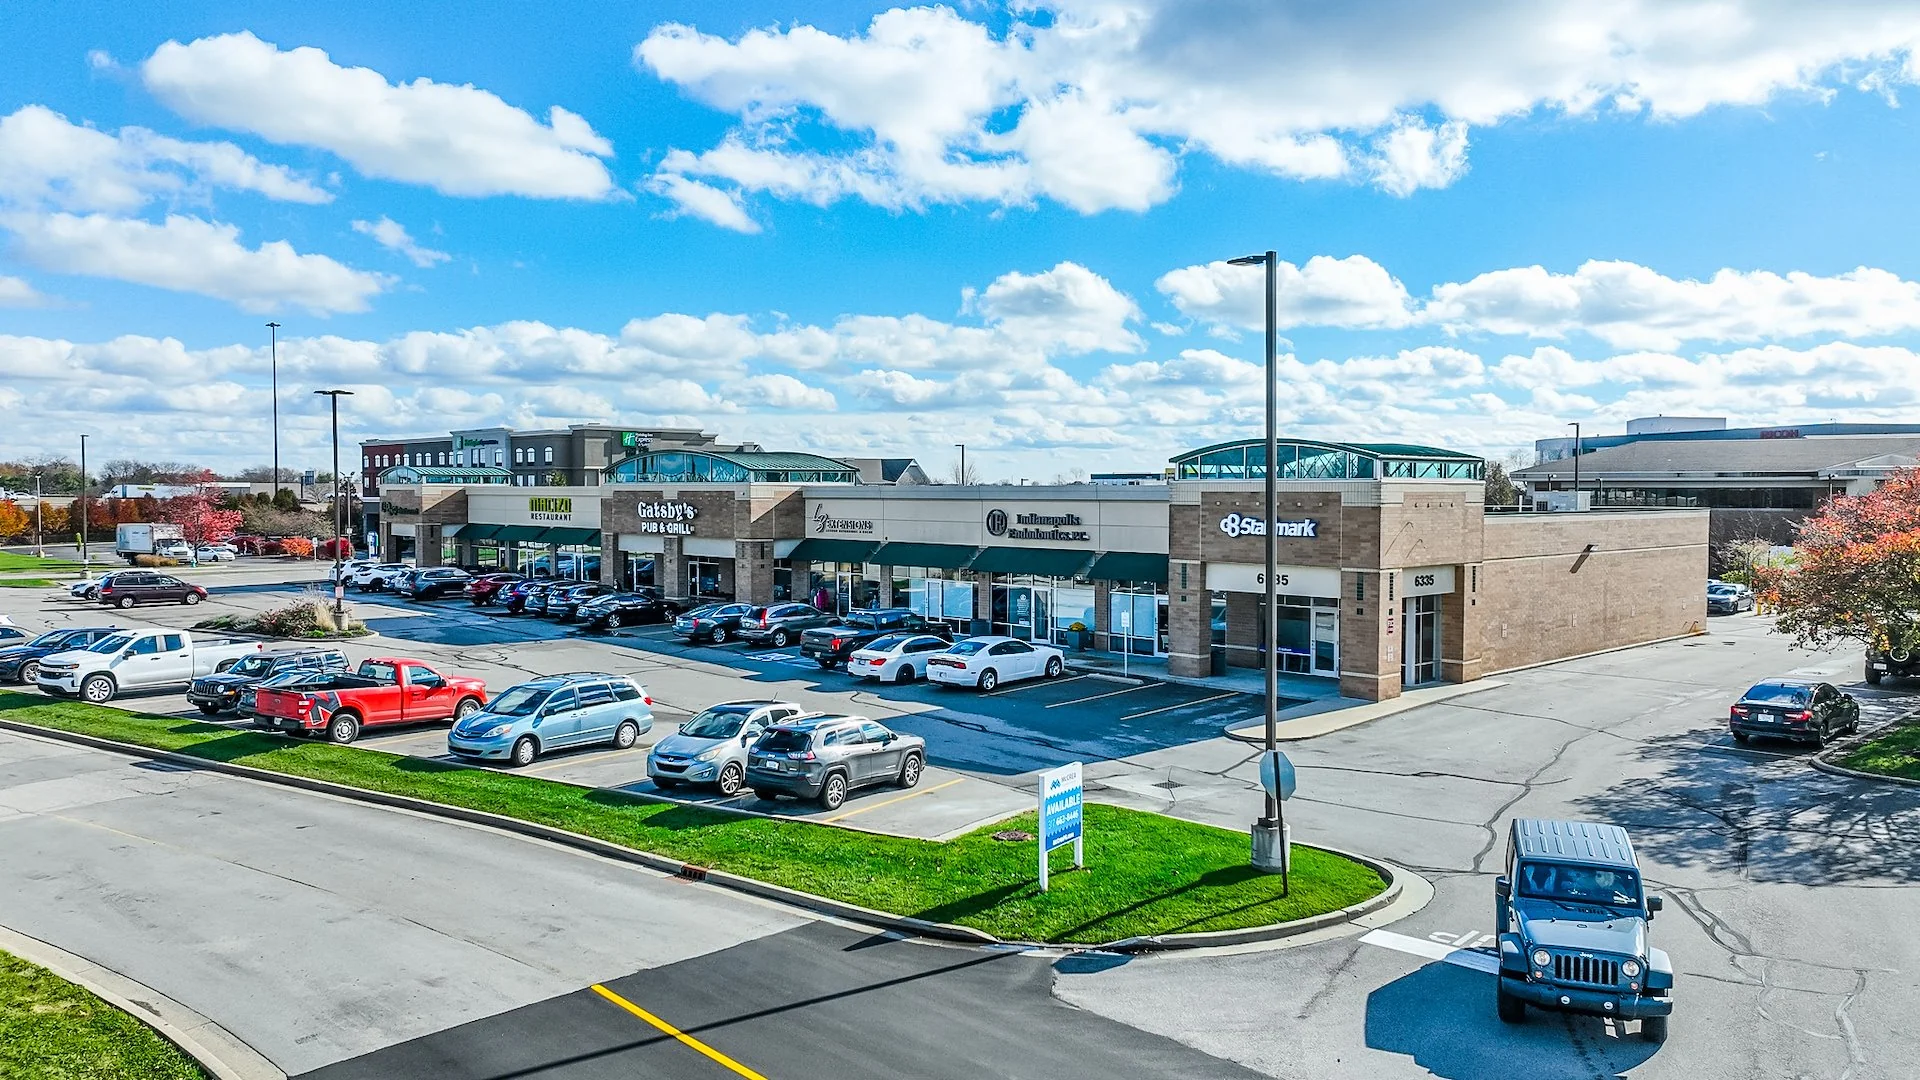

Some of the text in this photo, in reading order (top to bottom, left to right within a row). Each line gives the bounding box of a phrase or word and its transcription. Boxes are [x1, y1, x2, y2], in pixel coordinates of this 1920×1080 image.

[530, 513, 572, 521] RESTAURANT
[637, 501, 695, 521] Gatsby's
[1016, 513, 1081, 528] Indianapolis
[641, 521, 691, 535] PUB & GRILL
[1256, 573, 1289, 586] 635
[1415, 575, 1435, 587] 6335
[1046, 792, 1081, 817] AVAILABLE
